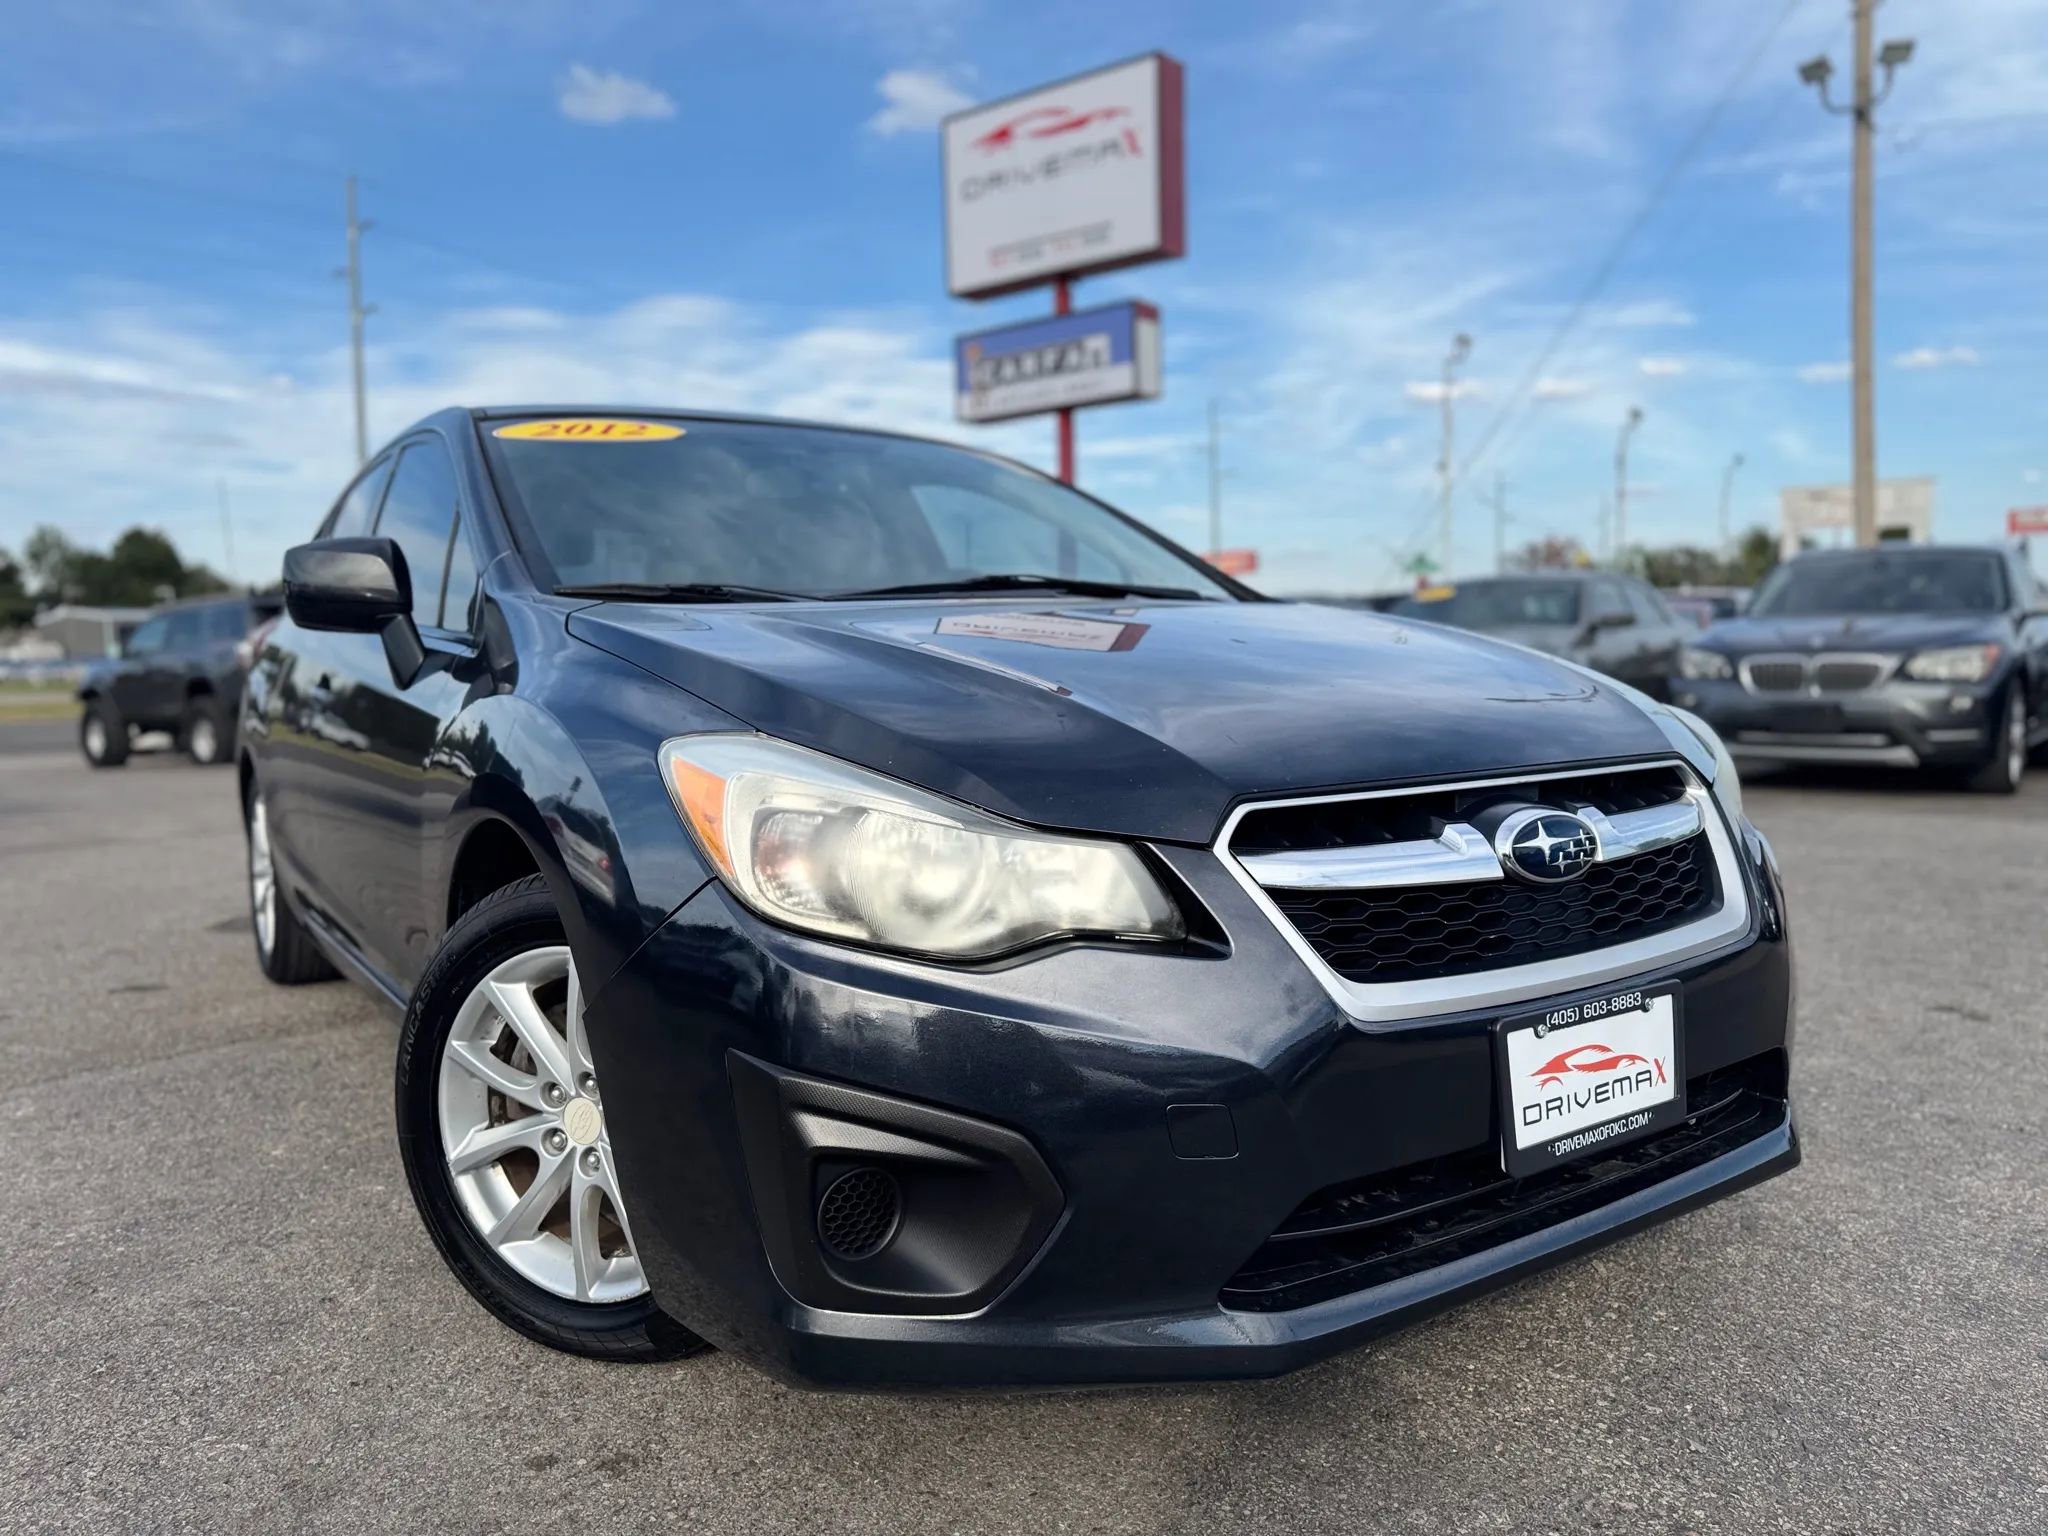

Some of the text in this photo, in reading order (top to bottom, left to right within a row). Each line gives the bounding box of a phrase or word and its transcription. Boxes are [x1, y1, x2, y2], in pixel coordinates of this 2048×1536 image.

[532, 422, 648, 437] 2012
[1546, 992, 1642, 1028] (405) 603-8883
[1523, 1056, 1667, 1126] DRIVEMAX
[1555, 1113, 1649, 1156] DRIVEMAXOFOKC.COM
